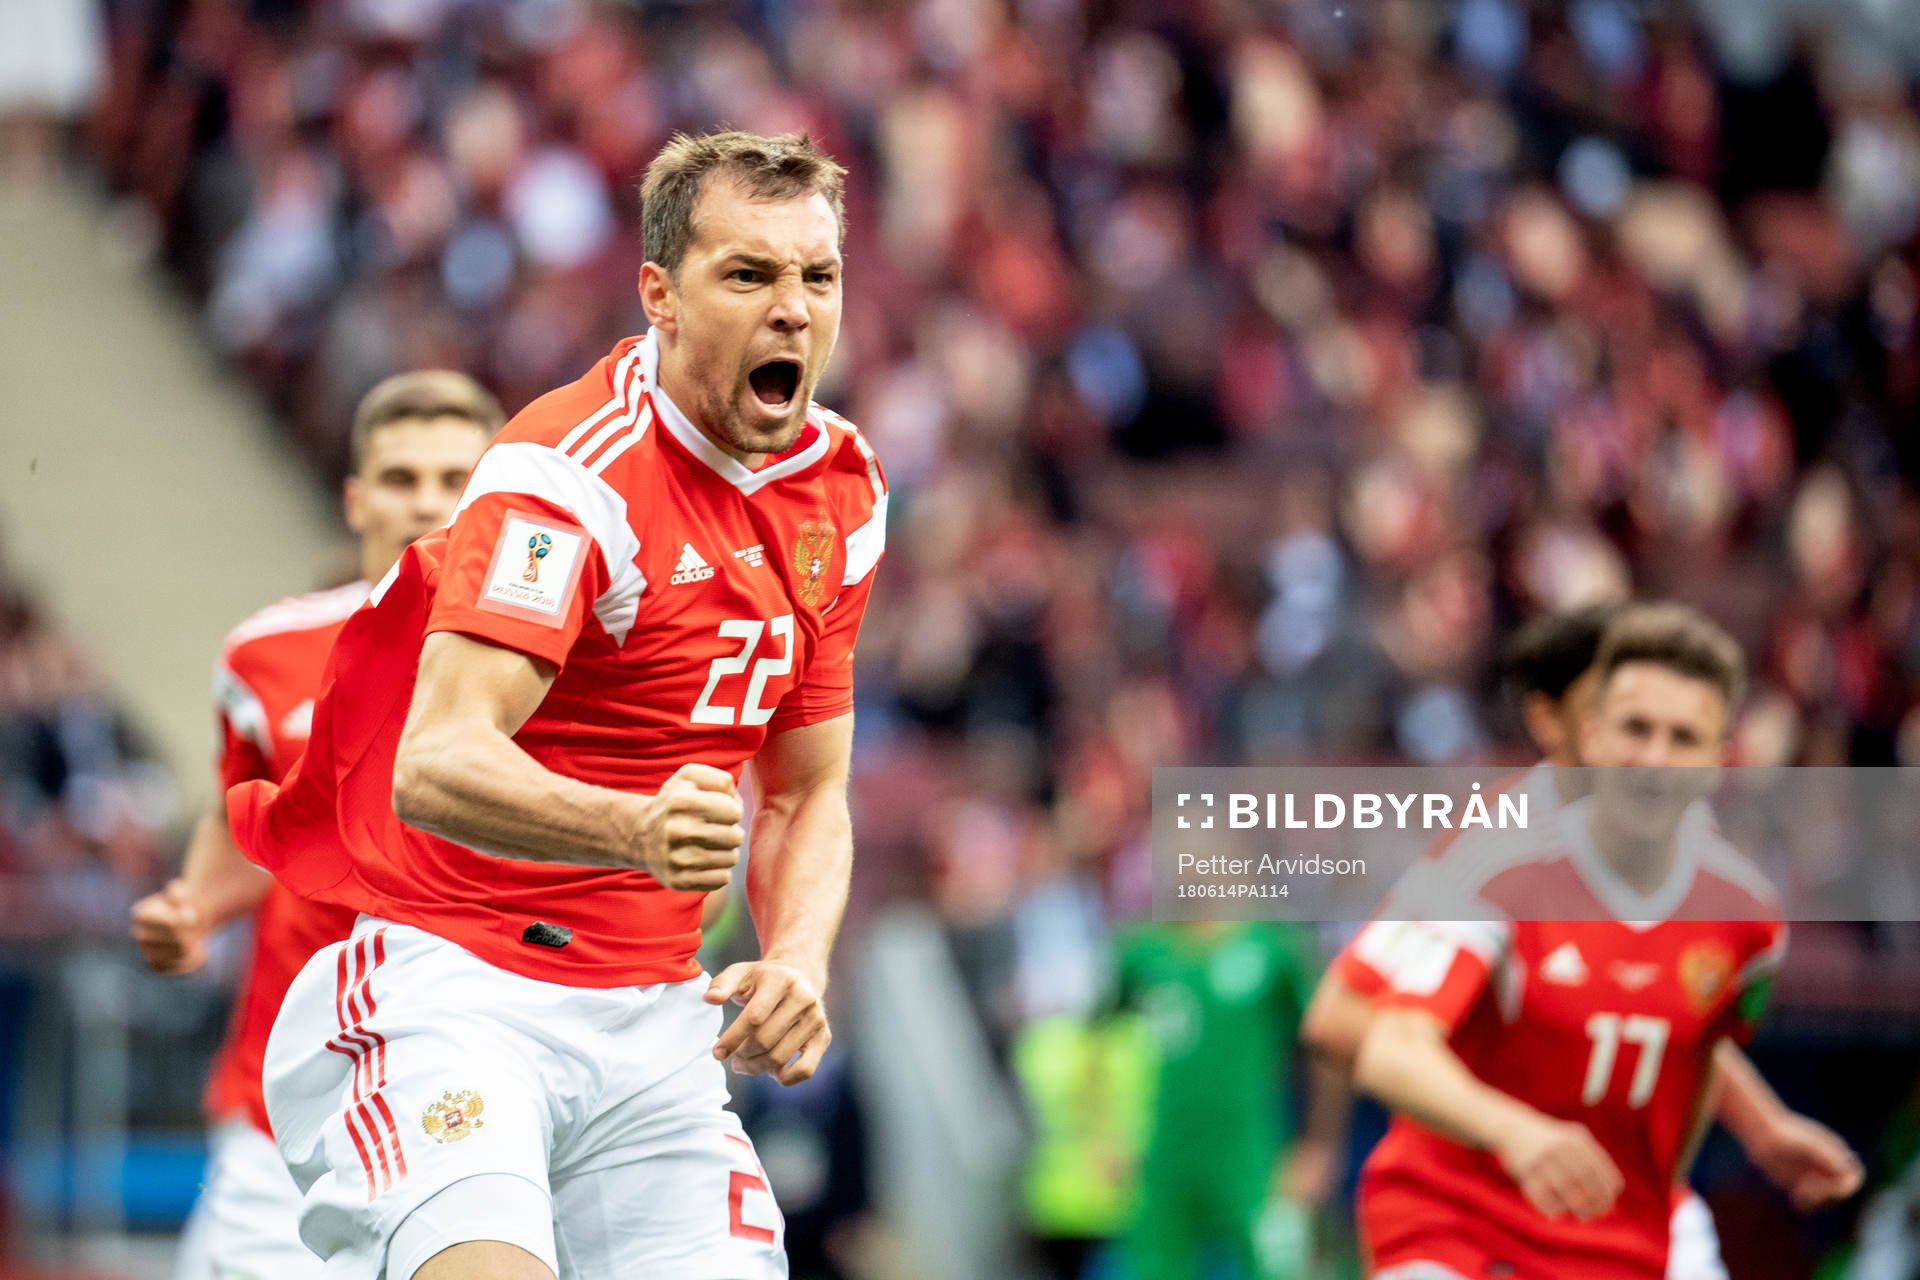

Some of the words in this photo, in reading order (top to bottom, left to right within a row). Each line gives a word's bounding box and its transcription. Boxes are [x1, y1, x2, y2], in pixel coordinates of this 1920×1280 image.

[670, 566, 714, 586] adidas
[690, 613, 794, 726] 22
[1581, 1011, 1671, 1110] 17
